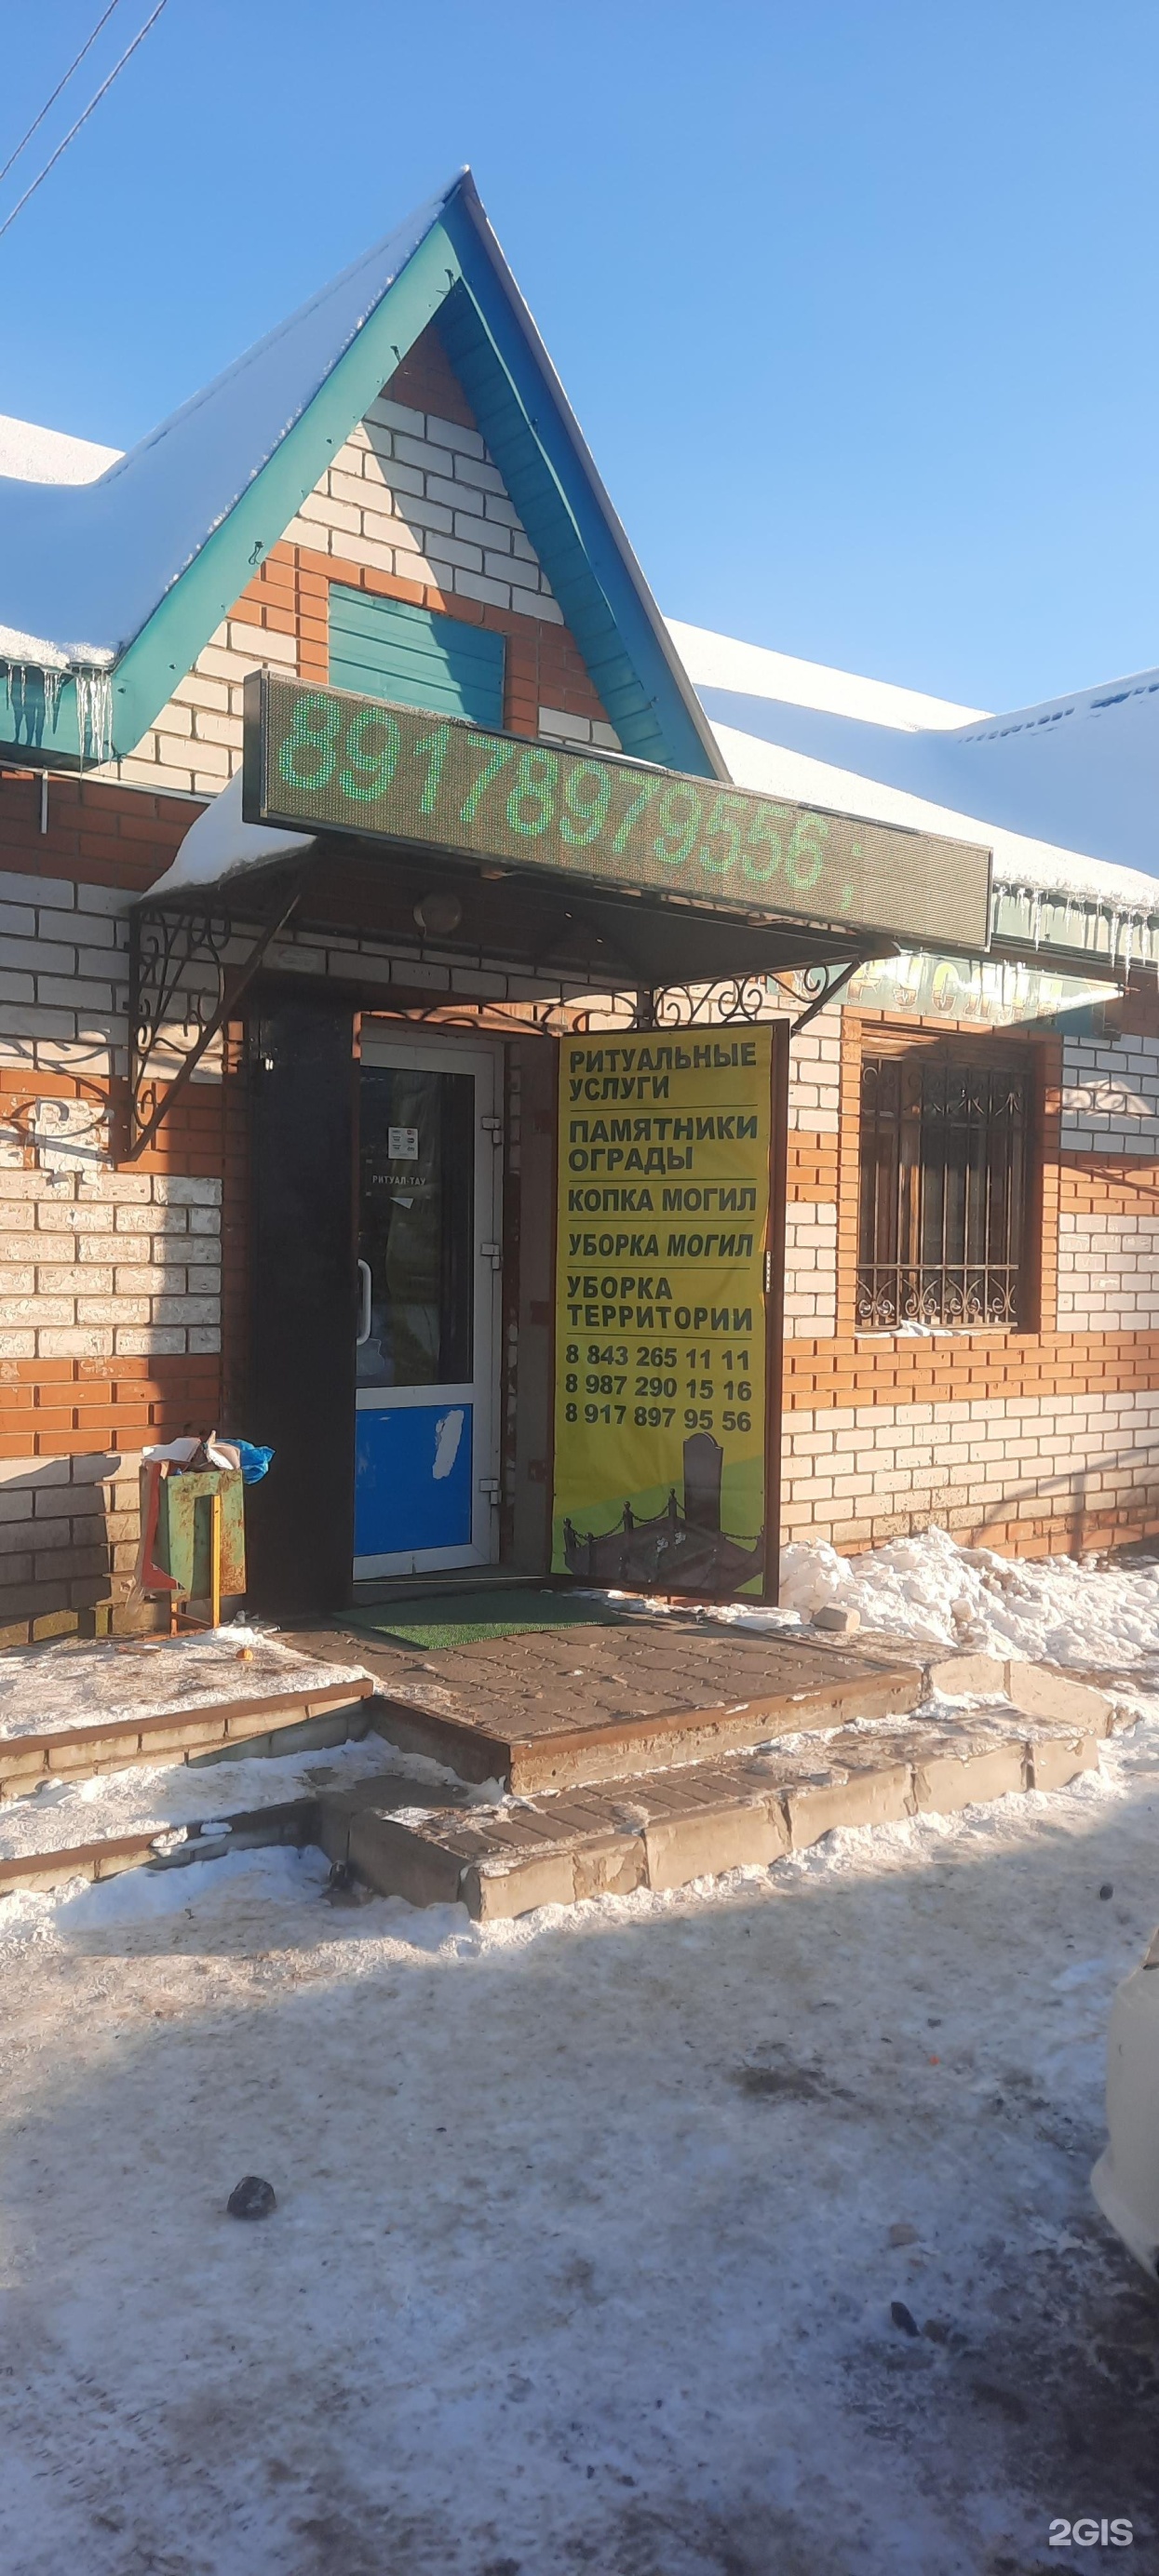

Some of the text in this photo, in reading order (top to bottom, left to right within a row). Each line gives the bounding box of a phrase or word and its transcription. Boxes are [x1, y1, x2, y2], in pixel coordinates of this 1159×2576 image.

[277, 693, 829, 891] 89178979556
[569, 1041, 758, 1073] РИТУАЛЬНЫЕ
[569, 1076, 670, 1101] УСЛУГИ
[569, 1116, 758, 1143] ПАМЯТНИКИ
[568, 1147, 694, 1174] ОГРАДЫ
[372, 1174, 426, 1186] РИТУАЛ-ТАУ
[568, 1187, 757, 1211] КОПКА МОГИЛ
[569, 1233, 753, 1257] УБОРКА МОГИЛ
[567, 1276, 673, 1300] УБОРКА
[567, 1305, 752, 1332] ТЕРРИТОРИИ
[565, 1344, 749, 1371] 8 843 265 11 11
[565, 1374, 752, 1402] 8 987 290 15 16
[565, 1402, 752, 1432] 8 917 897 95 56
